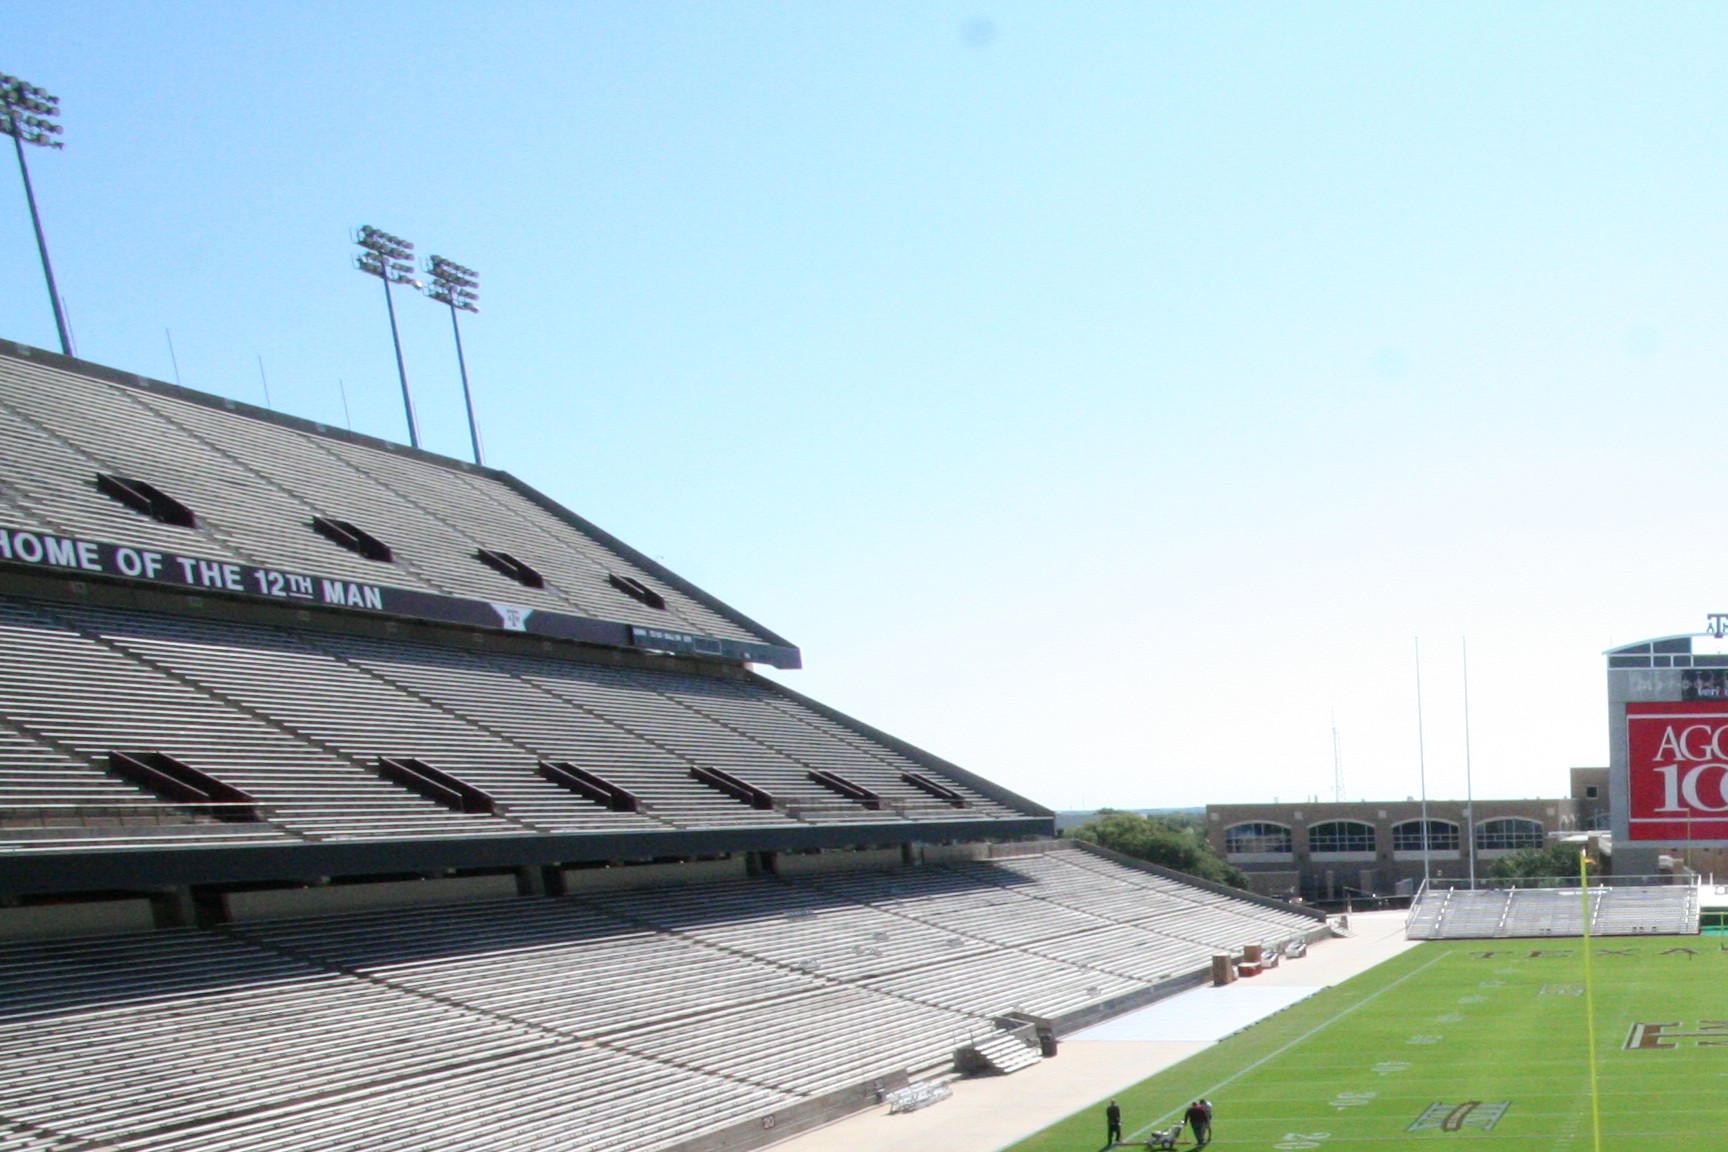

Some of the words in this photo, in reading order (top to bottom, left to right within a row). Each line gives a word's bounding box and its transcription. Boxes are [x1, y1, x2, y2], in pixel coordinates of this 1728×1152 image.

[0, 529, 102, 571] HOME
[116, 547, 162, 578] OF
[176, 556, 244, 591] THE
[322, 579, 383, 610] MAN
